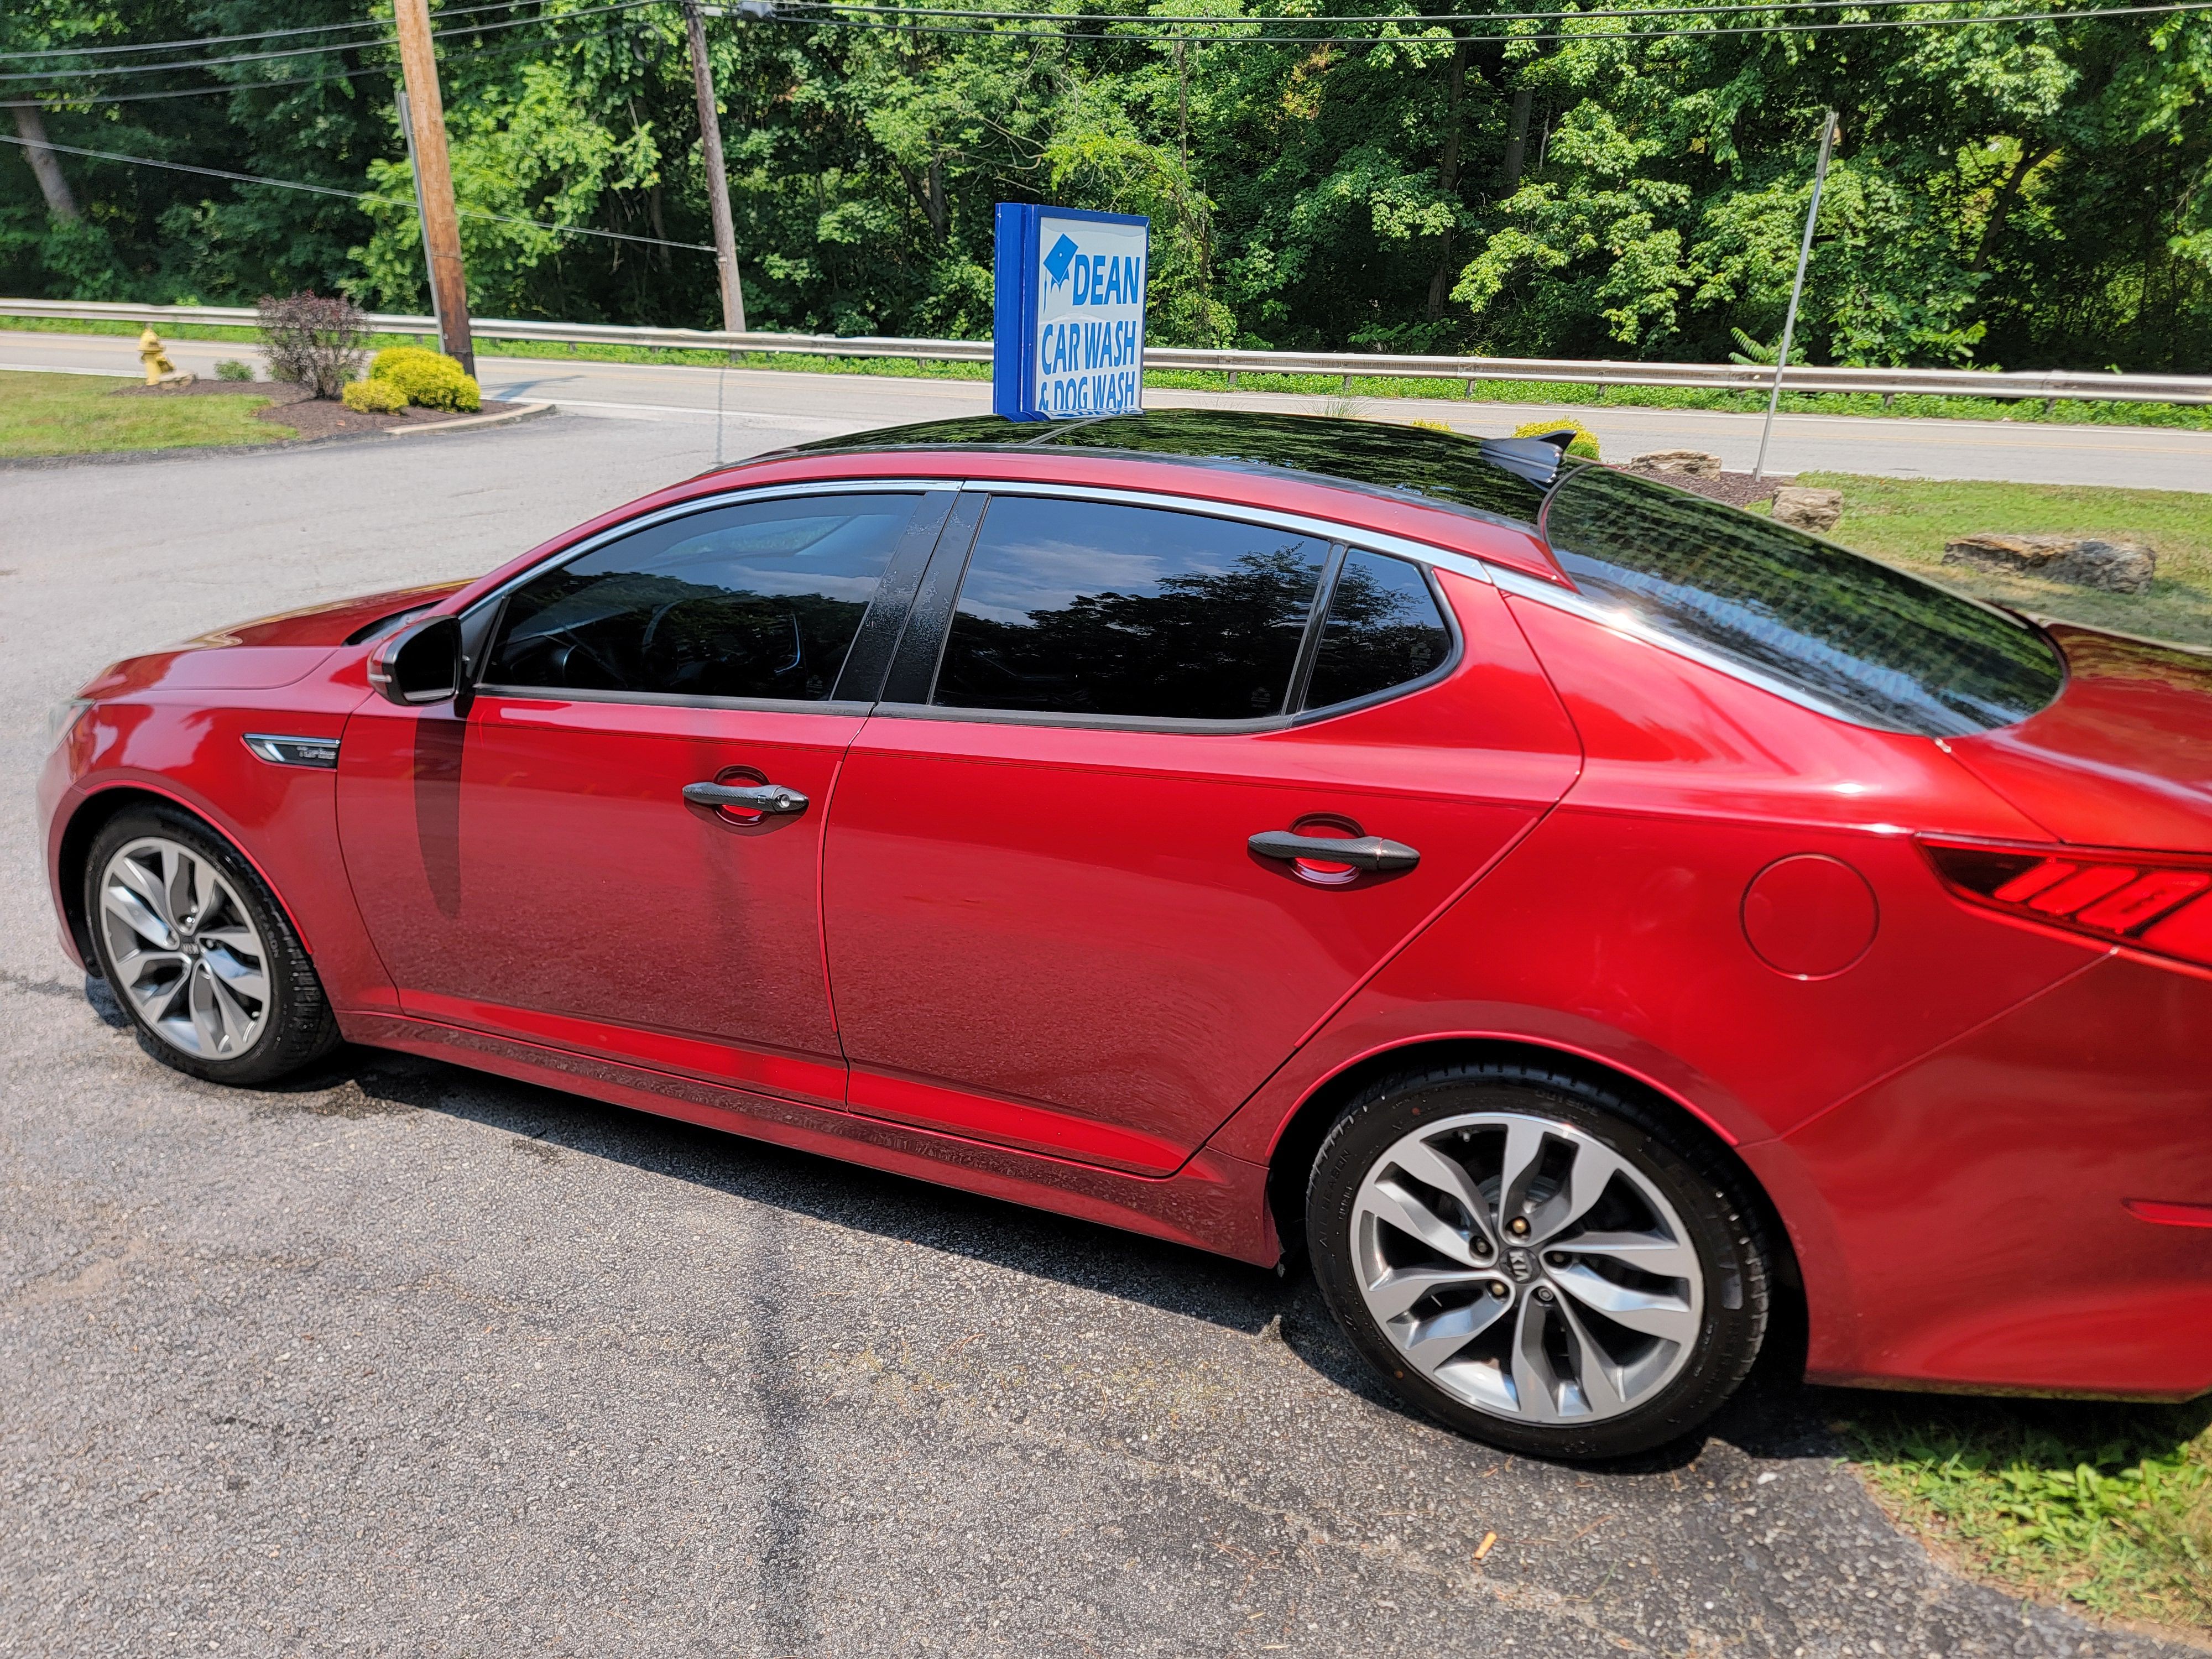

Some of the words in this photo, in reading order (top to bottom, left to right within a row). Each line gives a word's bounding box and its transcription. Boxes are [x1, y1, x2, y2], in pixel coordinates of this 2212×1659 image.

[1072, 254, 1140, 306] DEAN
[1041, 323, 1080, 375] CAR
[1084, 320, 1136, 370] WASH
[1039, 381, 1049, 410] &
[1054, 377, 1088, 410] DOG
[1092, 371, 1136, 408] WASH
[1509, 1250, 1530, 1282] KIA
